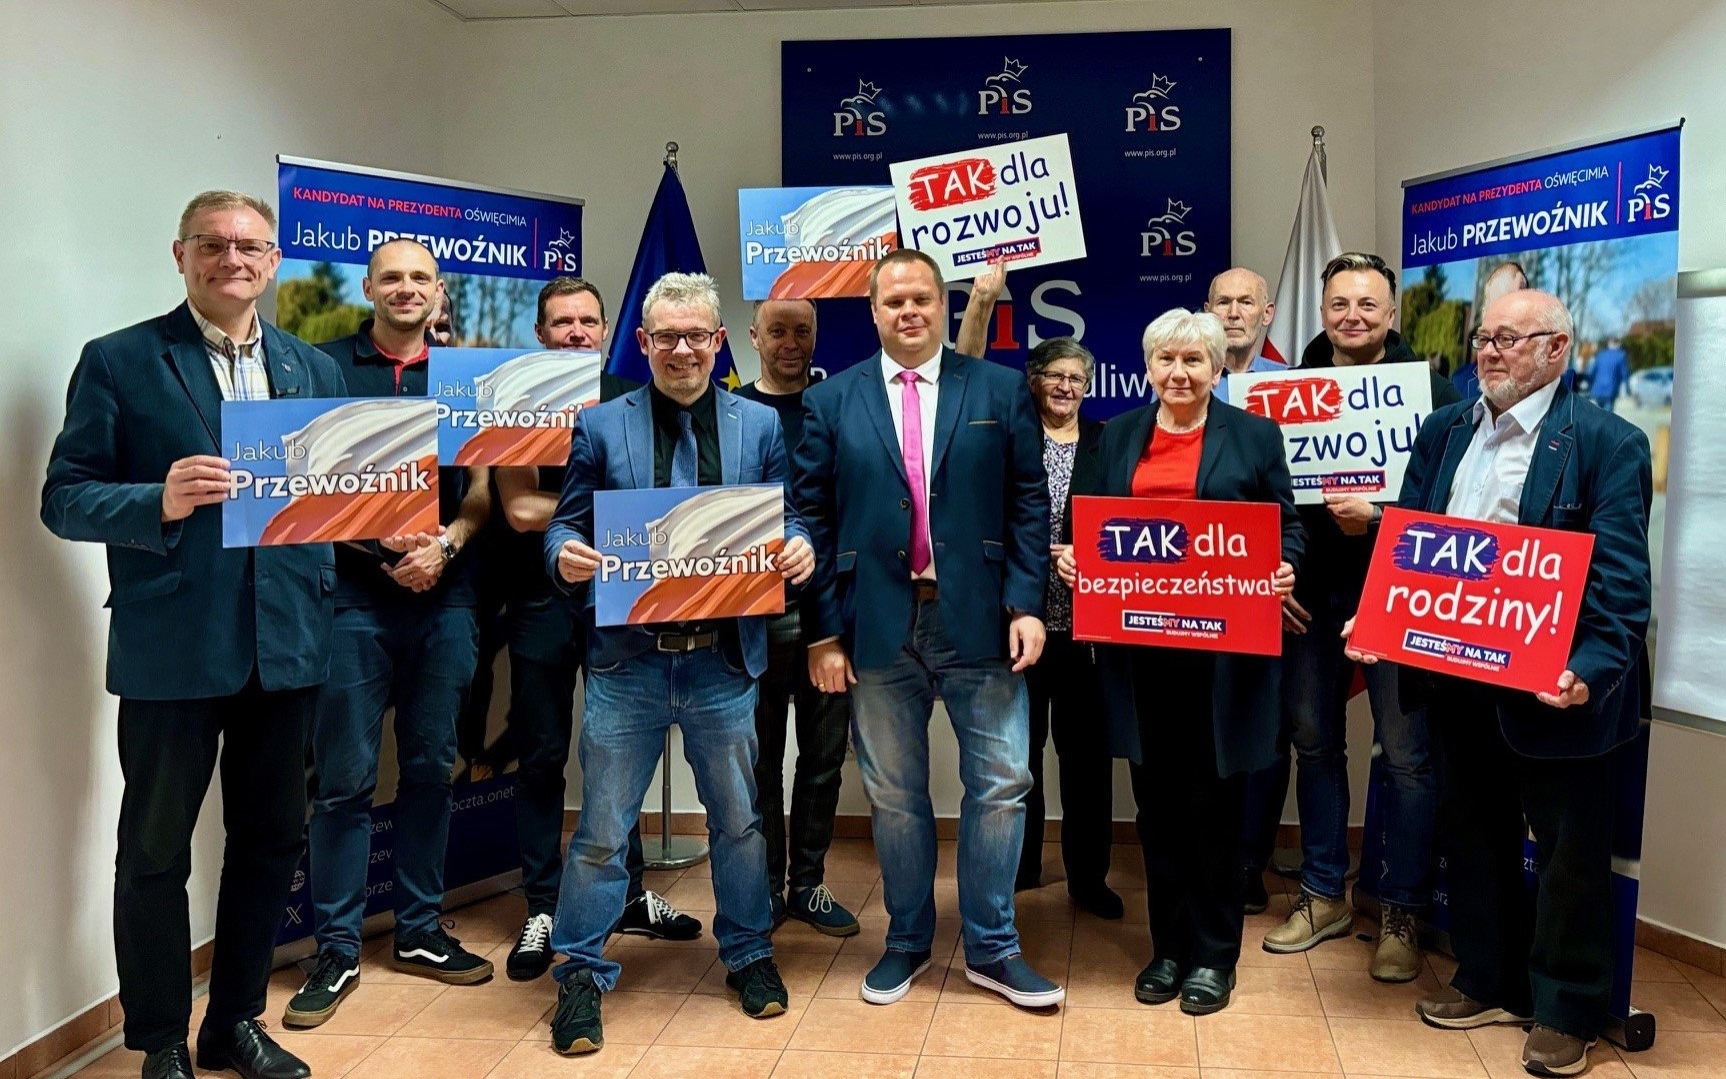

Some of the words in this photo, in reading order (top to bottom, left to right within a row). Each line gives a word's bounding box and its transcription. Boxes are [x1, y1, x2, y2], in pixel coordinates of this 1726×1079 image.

[978, 89, 1032, 115] PiS
[833, 111, 887, 136] PiS
[1125, 106, 1181, 132] PiS
[977, 131, 1029, 142] www.pis.org.pl
[832, 152, 883, 163] www.pis.org.pl
[1124, 149, 1177, 160] www.pis.org.pl
[916, 162, 991, 203] TAK
[1000, 151, 1050, 186] dla
[1411, 195, 1461, 215] KANDYDAT
[1462, 193, 1478, 204] NA
[1479, 178, 1543, 202] PREZYDENTA
[1544, 165, 1609, 190] OŚWIĘCIMIA
[293, 187, 365, 207] KANDYDAT
[367, 197, 385, 209] NA
[388, 200, 463, 219] PREZYDENTA
[464, 206, 527, 227] OŚWIĘCIMIA
[911, 181, 1070, 250] rozwoju!
[1627, 193, 1671, 223] PiS
[291, 221, 361, 250] Jakub
[746, 220, 800, 235] Jakub
[1411, 231, 1458, 255] Jakub
[1463, 201, 1608, 247] PRZEWOŹNIK
[746, 236, 892, 264] Przewoźnik
[957, 247, 1001, 263] JESTEŚMY
[1001, 245, 1017, 255] NA
[1016, 241, 1036, 252] TAK
[1140, 230, 1197, 257] PiS
[543, 249, 577, 272] PiS
[1140, 273, 1192, 284] www.pis.org.pl
[434, 380, 494, 398] Jakub
[1252, 382, 1336, 420] TAK
[1348, 376, 1405, 411] dla
[437, 402, 583, 429] Przewoźni
[230, 440, 307, 462] Jakub
[229, 461, 432, 500] Przewoźnik
[1292, 475, 1338, 487] ESTEŚMY
[1341, 475, 1355, 485] NA
[1358, 474, 1380, 484] TAK
[602, 526, 668, 548] Jakub
[1105, 525, 1183, 557] TAK
[1194, 523, 1248, 557] dla
[600, 544, 778, 583] Przewoźnik
[1407, 529, 1492, 573] TAK
[1502, 538, 1562, 580] dla
[1078, 570, 1278, 601] bezpieczeństwa!
[1129, 615, 1180, 627] JESTEŚMY
[1182, 619, 1198, 629] NA
[1200, 620, 1222, 631] TAK
[1385, 581, 1564, 645] rodziny!
[1410, 635, 1464, 655] JESTEŚMY
[1464, 647, 1481, 659] NA
[1483, 650, 1506, 664] TAK
